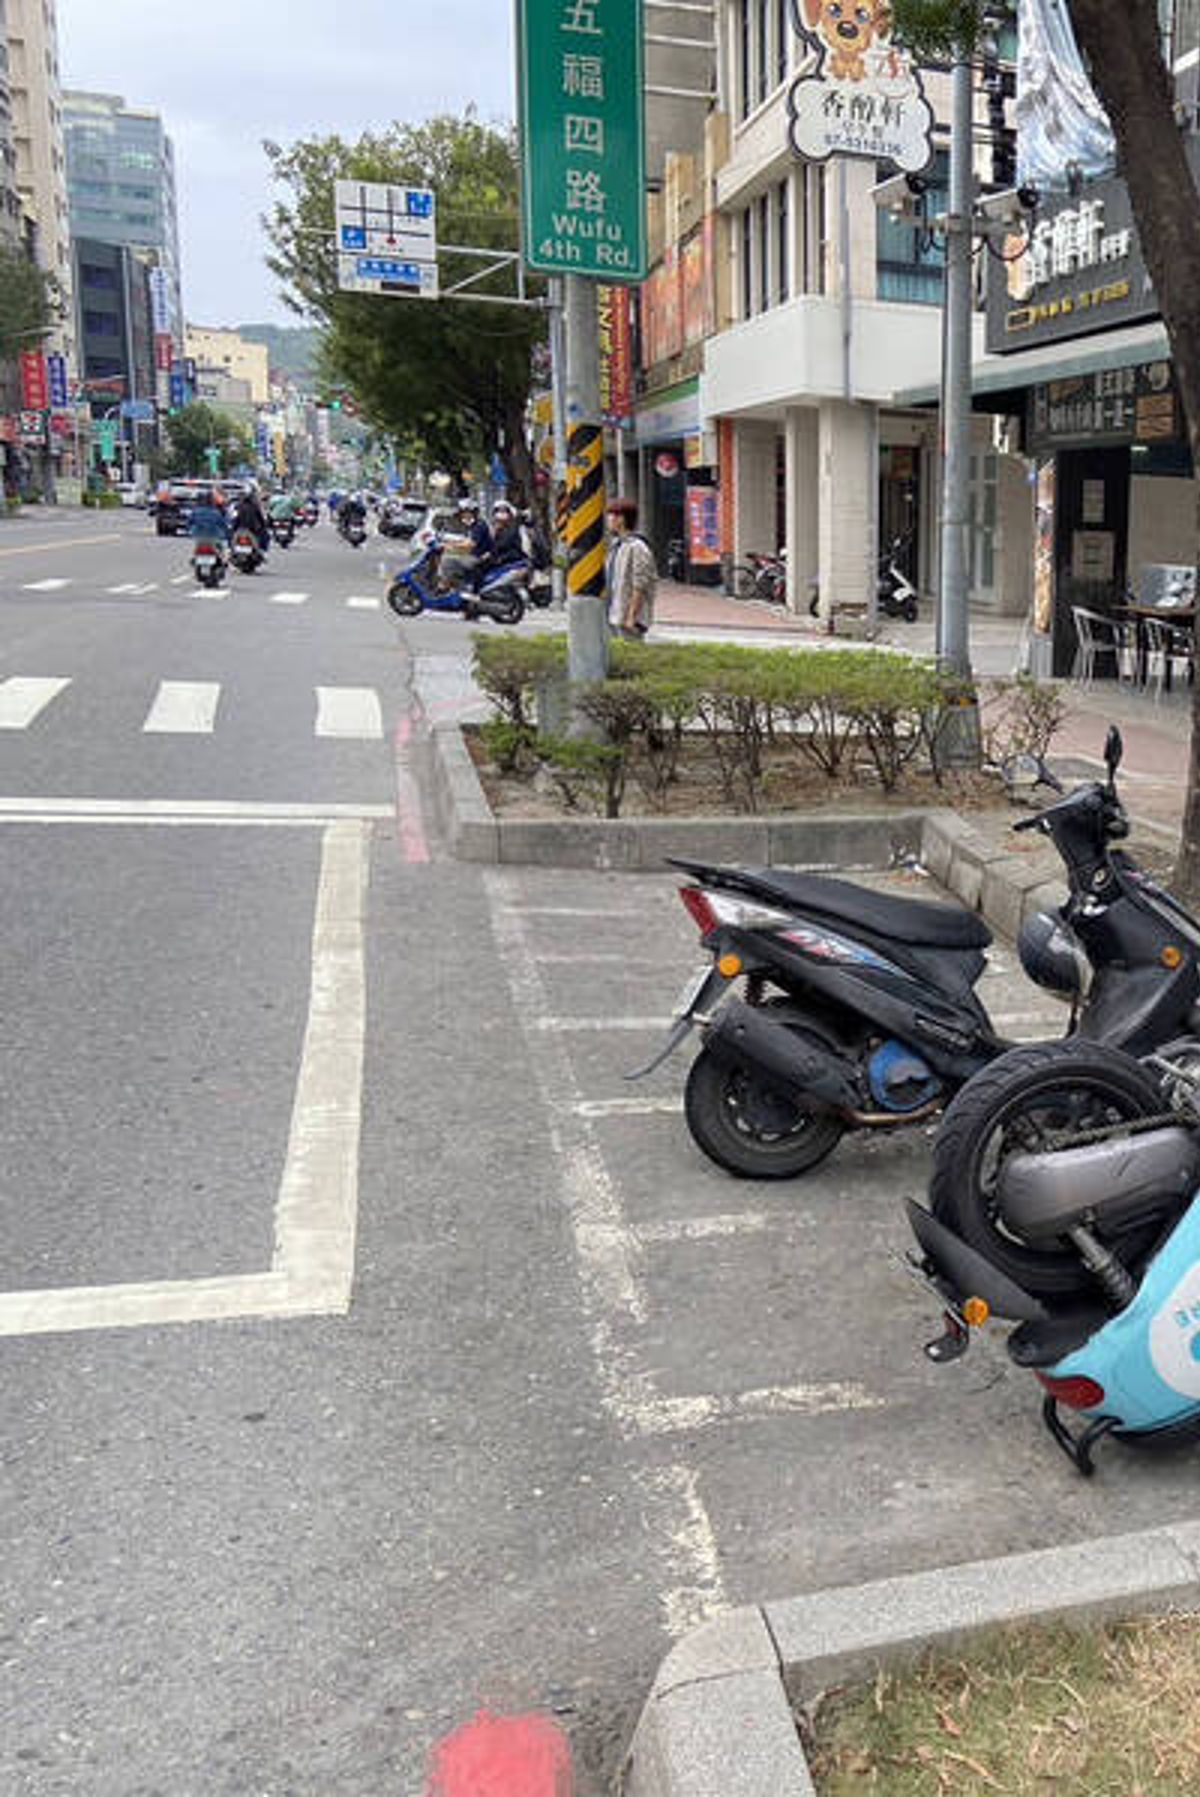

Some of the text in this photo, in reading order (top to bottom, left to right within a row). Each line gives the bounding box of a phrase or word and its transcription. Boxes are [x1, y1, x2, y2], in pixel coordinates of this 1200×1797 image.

[560, 0, 605, 213] 五福四路
[552, 213, 621, 241] Wufu
[539, 239, 580, 262] 4th
